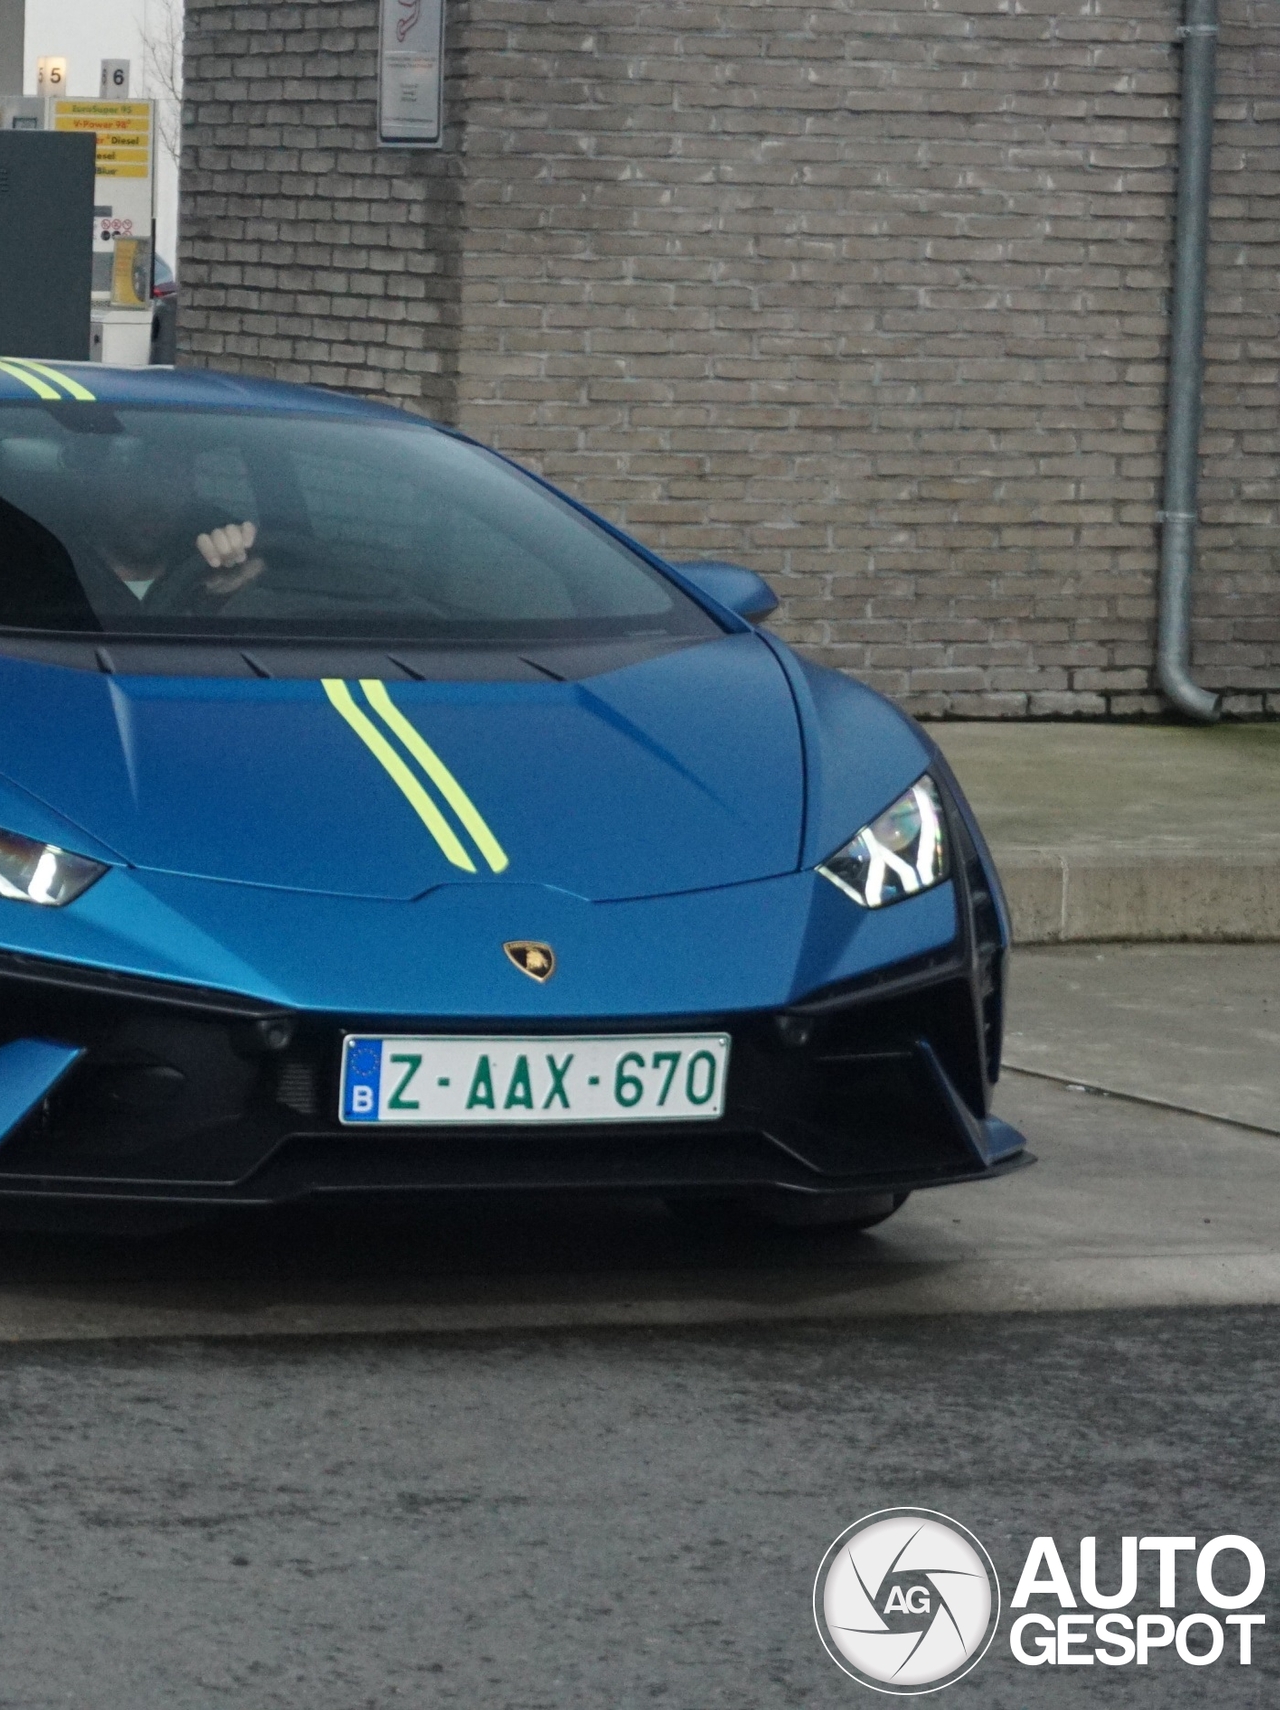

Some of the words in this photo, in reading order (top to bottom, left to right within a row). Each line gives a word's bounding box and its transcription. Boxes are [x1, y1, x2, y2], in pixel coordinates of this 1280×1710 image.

[50, 67, 61, 84] 5
[113, 68, 124, 85] 6
[72, 104, 117, 114] EuroSuper
[121, 104, 132, 114] 95
[73, 119, 113, 128] V-Power
[111, 136, 139, 145] Diesel
[96, 151, 116, 160] esel
[352, 1085, 373, 1113] B
